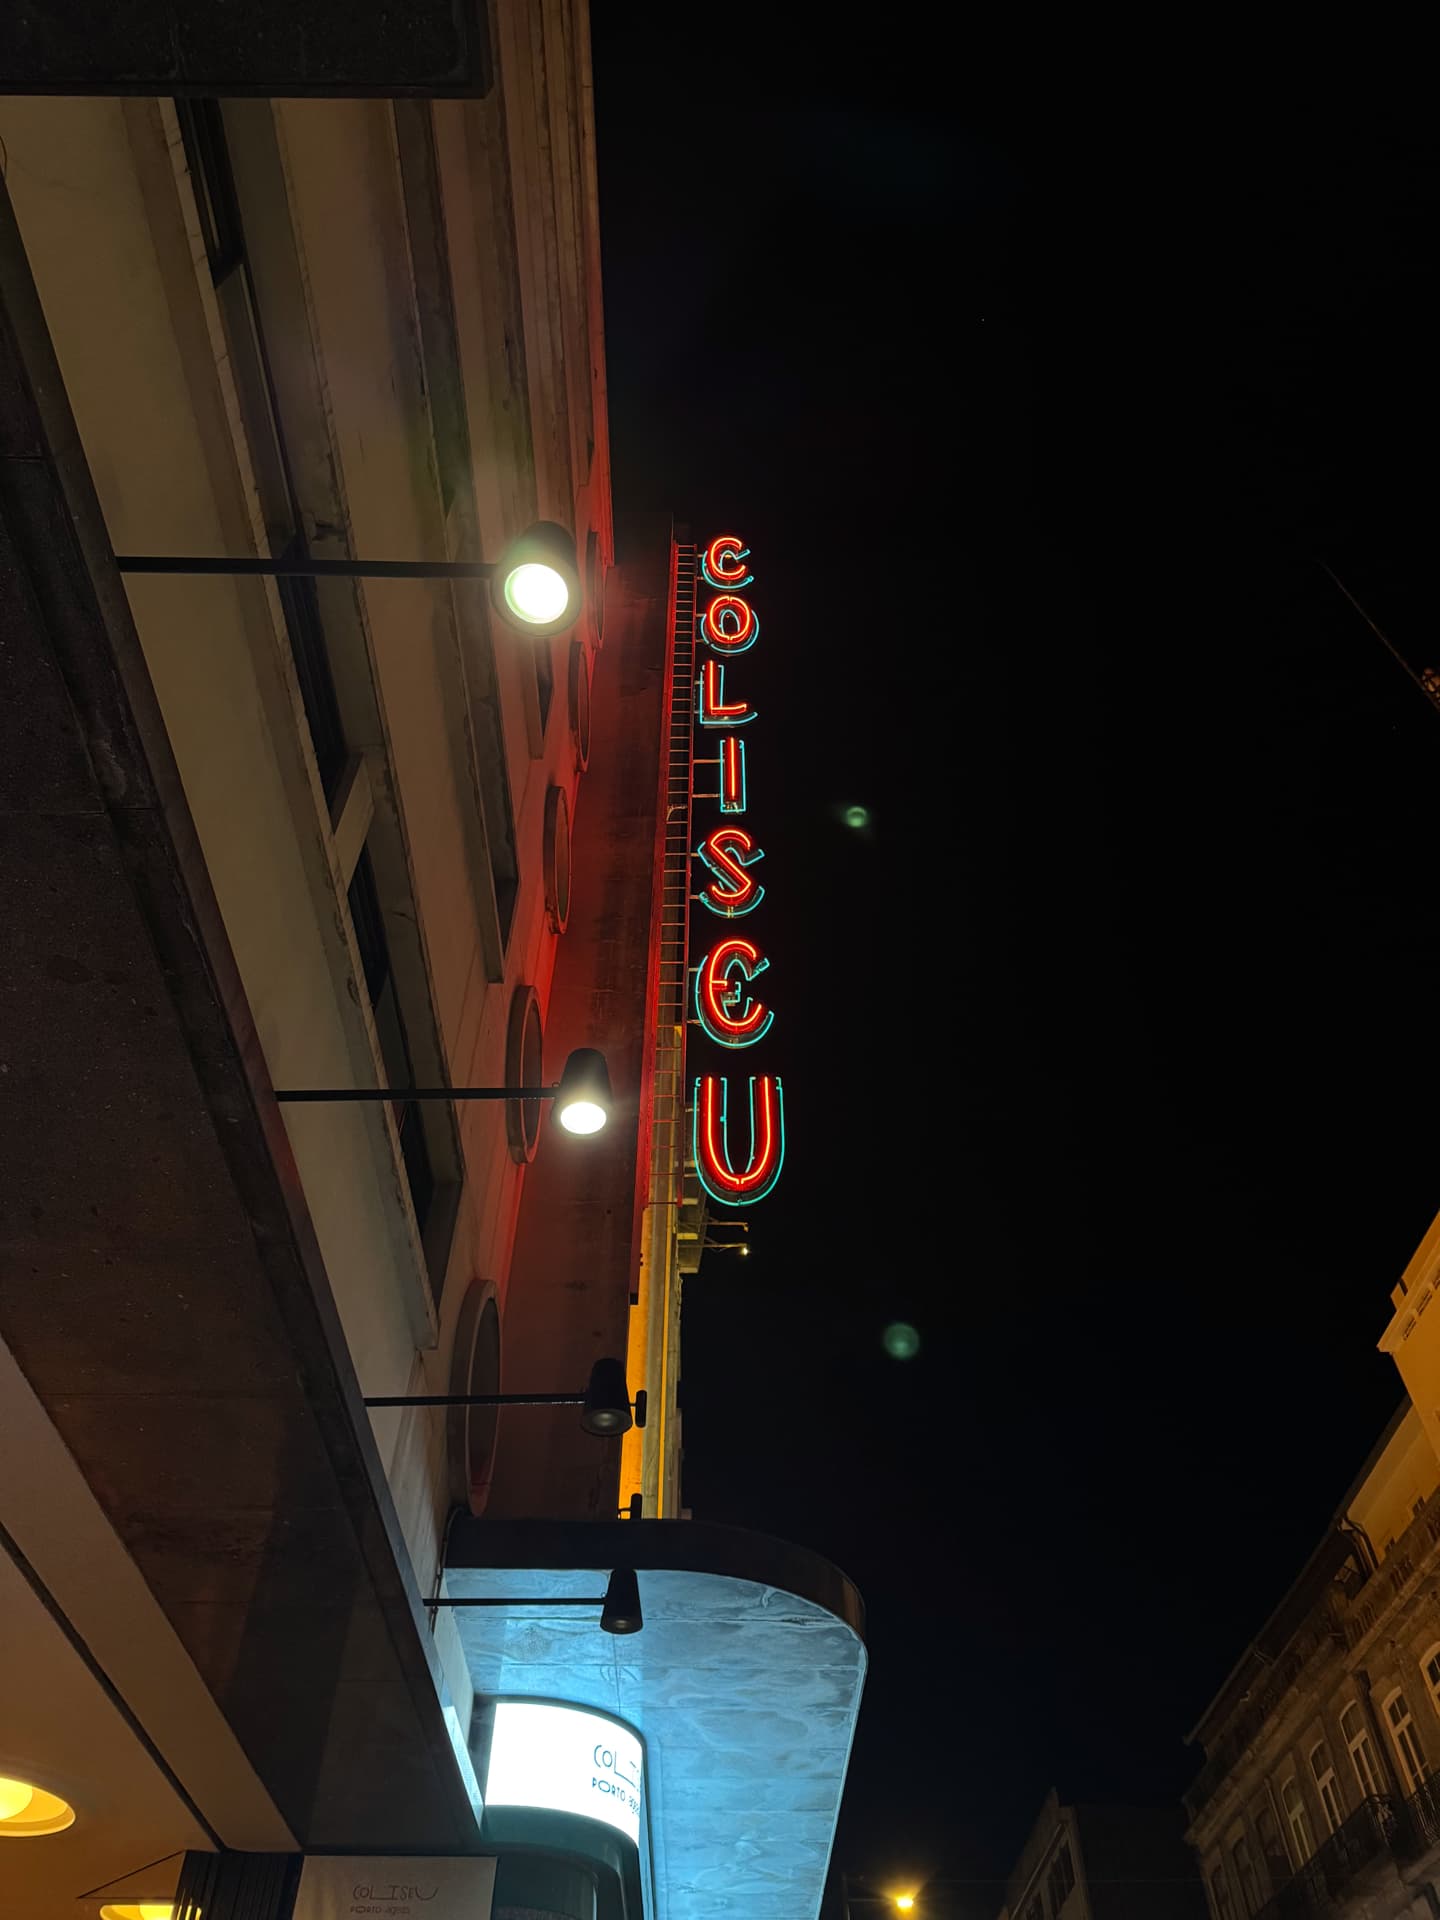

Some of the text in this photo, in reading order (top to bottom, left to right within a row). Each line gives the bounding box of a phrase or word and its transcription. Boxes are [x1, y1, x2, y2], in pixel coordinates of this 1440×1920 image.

[693, 537, 785, 1206] COLISEU
[592, 1776, 626, 1802] PORTO
[352, 1883, 440, 1901] COLISEU
